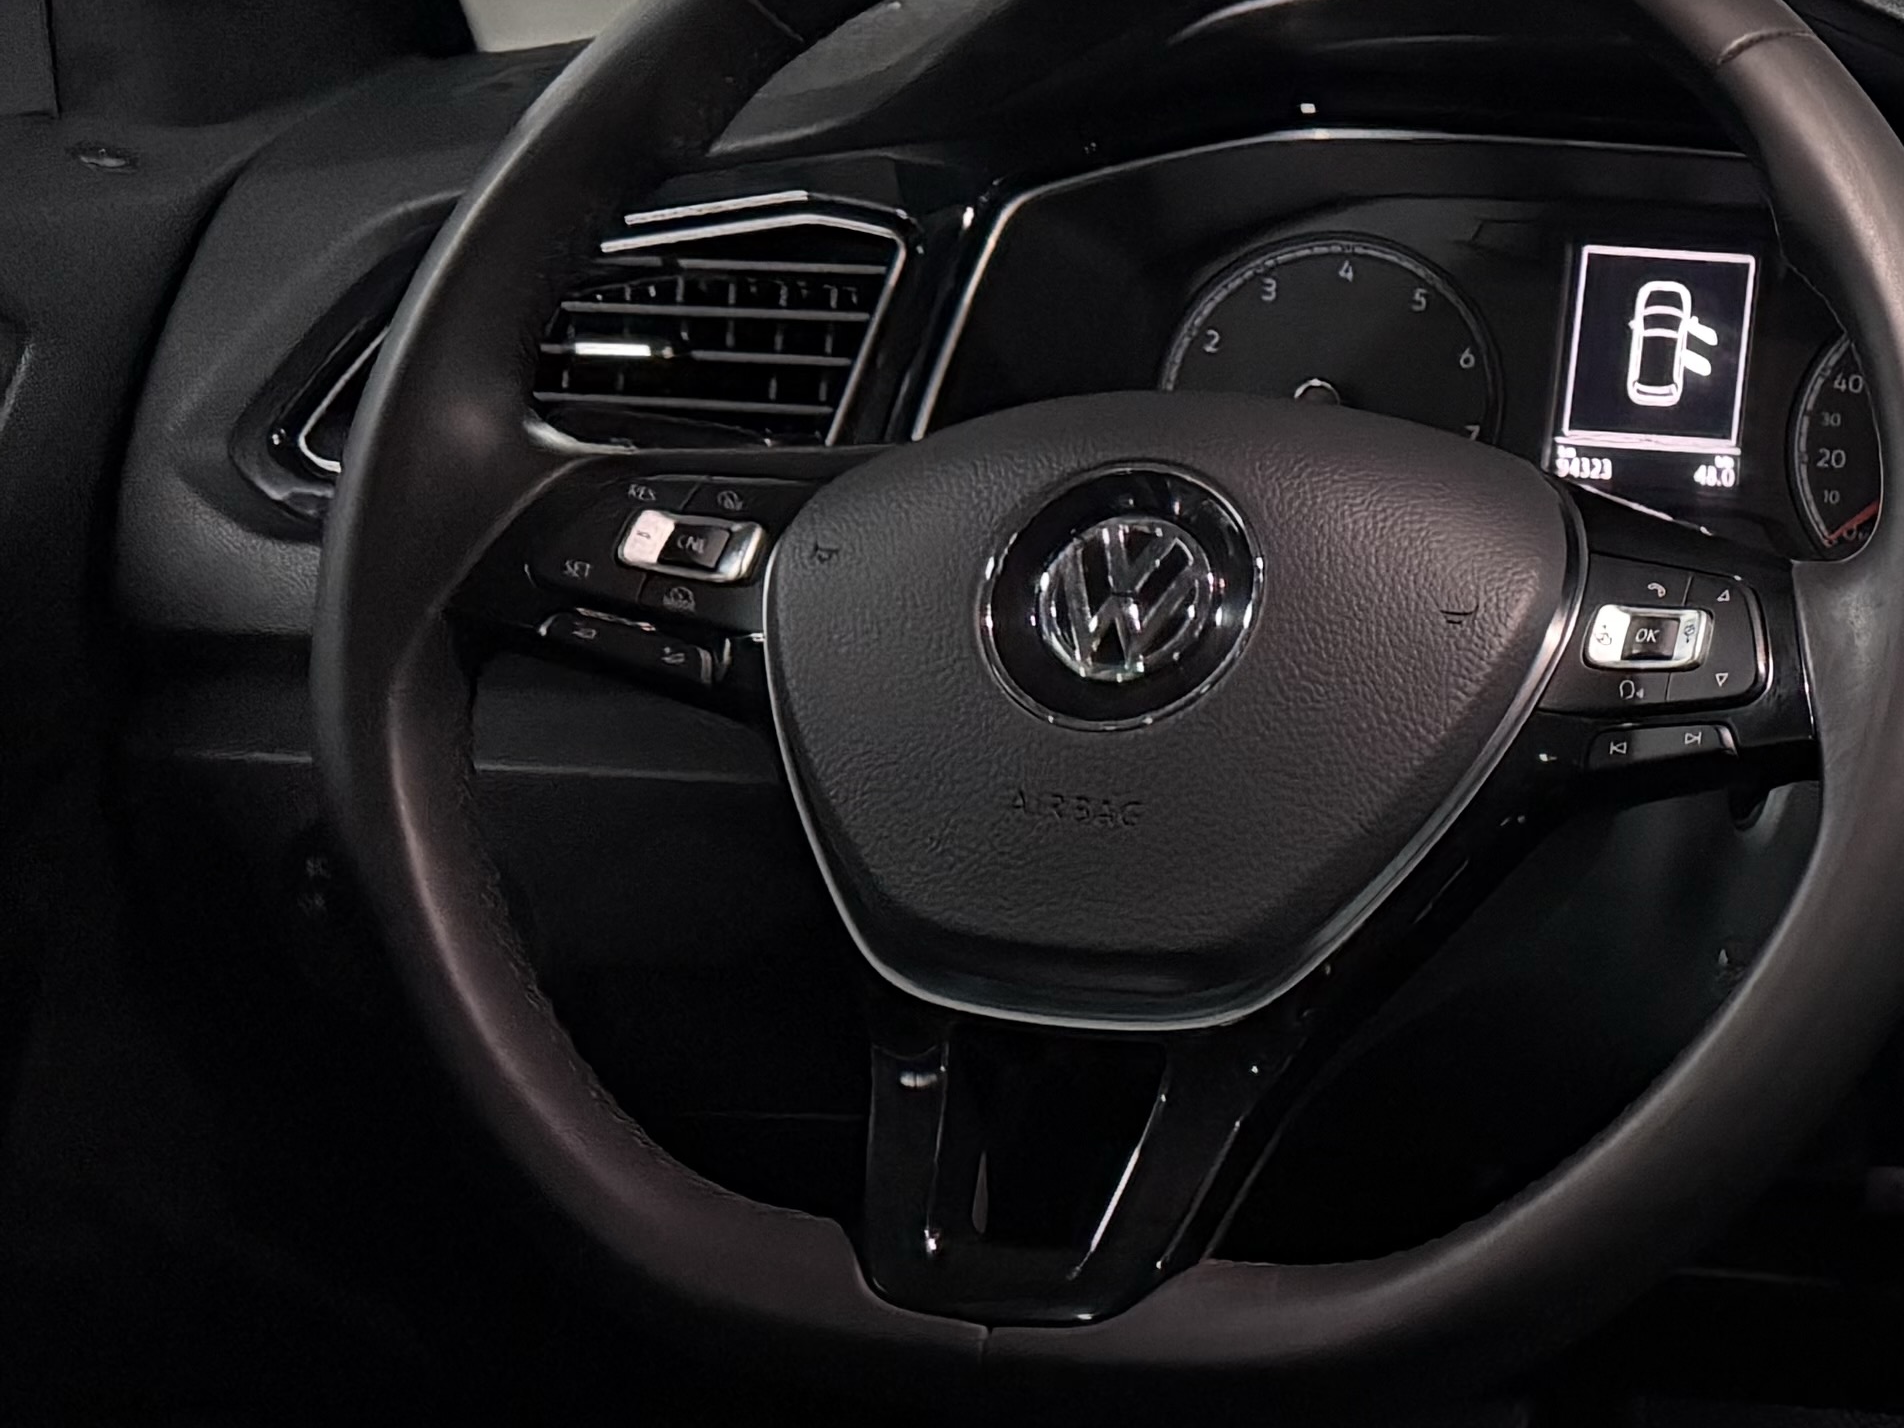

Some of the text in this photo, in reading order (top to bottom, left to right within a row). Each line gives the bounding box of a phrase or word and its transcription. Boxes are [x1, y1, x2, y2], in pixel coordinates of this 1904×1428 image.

[1338, 260, 1354, 282] 4
[1261, 277, 1277, 301] 3
[1411, 287, 1428, 312] 5
[1203, 329, 1220, 353] 2
[1459, 347, 1476, 369] 6
[1833, 372, 1863, 394] 40
[1821, 412, 1841, 426] 30
[1816, 448, 1847, 469] 20
[1823, 489, 1840, 504] 10
[1635, 628, 1660, 643] OK
